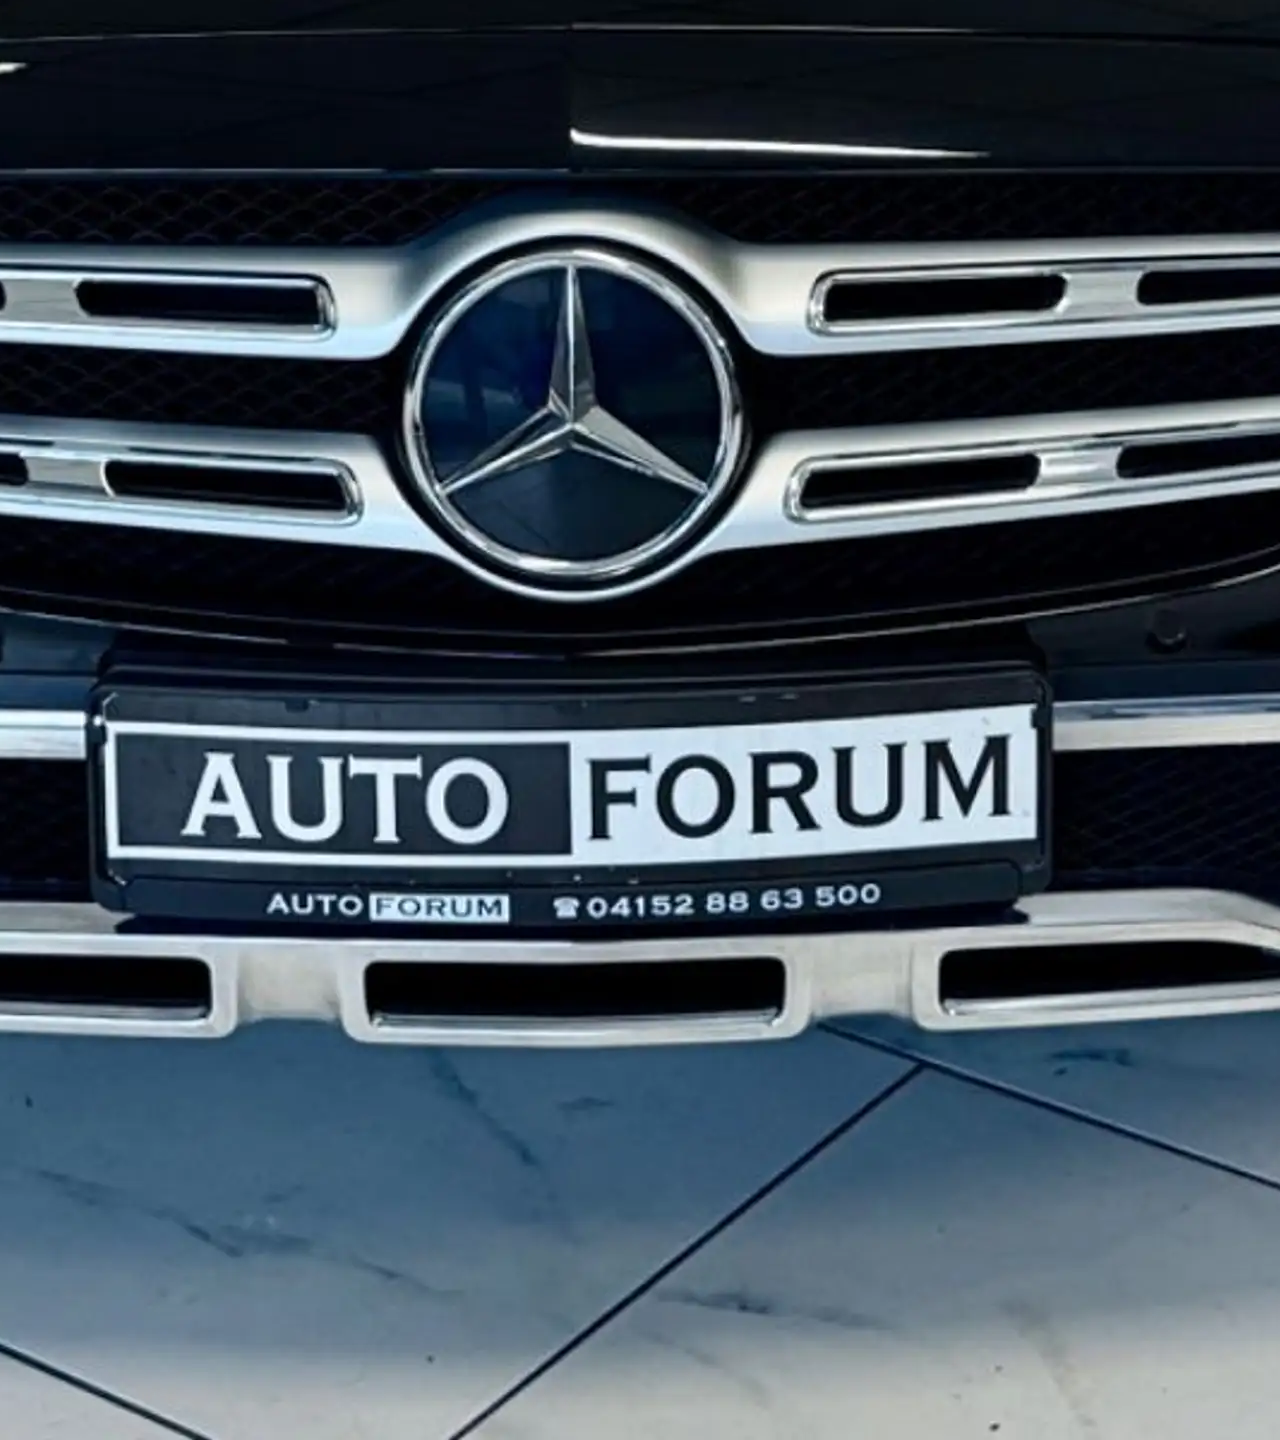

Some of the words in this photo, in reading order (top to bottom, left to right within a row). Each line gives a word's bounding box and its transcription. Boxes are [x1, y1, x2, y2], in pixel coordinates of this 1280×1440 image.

[180, 751, 510, 845] AUTO
[587, 734, 1012, 838] FORUM
[266, 892, 365, 917] AUTO
[375, 897, 504, 918] FORUM
[585, 894, 695, 919] 04152
[706, 891, 750, 913] 88
[760, 888, 804, 910] 63
[815, 883, 881, 907] 500
